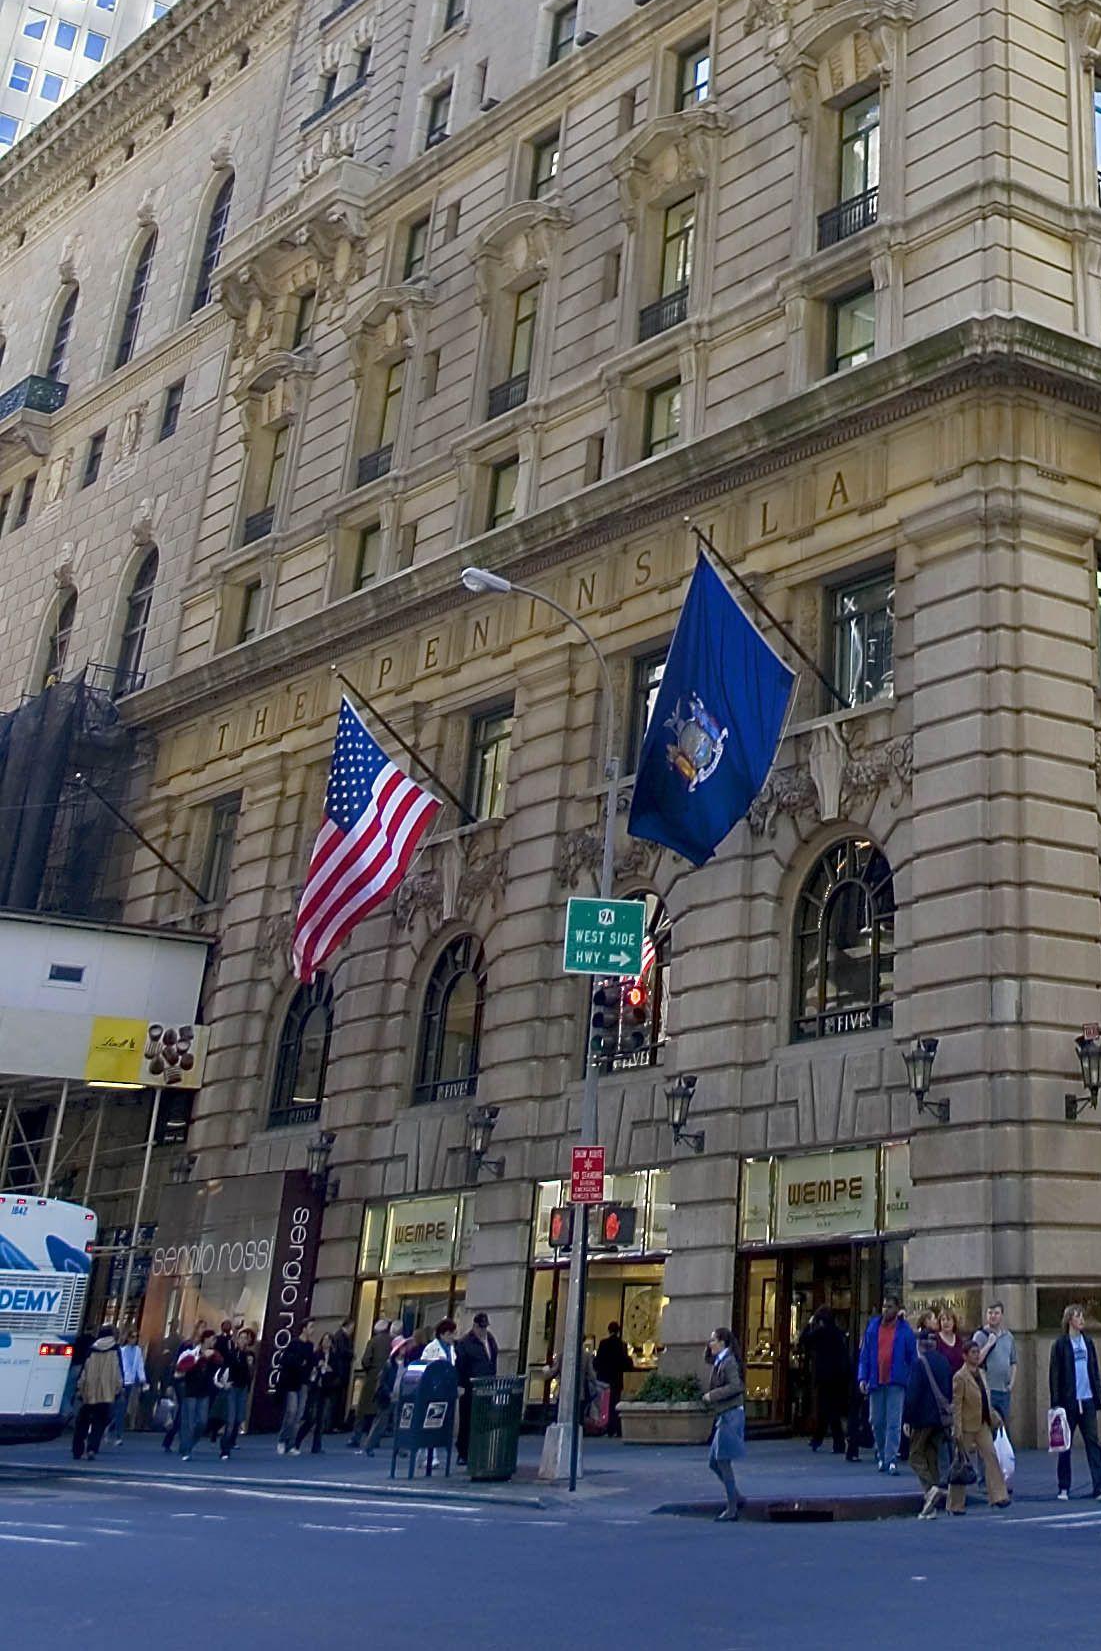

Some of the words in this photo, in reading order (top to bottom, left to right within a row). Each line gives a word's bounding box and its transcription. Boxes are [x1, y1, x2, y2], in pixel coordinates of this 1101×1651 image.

[217, 690, 308, 753] THE
[600, 910, 613, 923] 9A
[575, 929, 605, 946] WEST
[609, 931, 636, 947] SIDE
[576, 950, 601, 965] HWY
[838, 1011, 872, 1032] FIVES
[788, 1175, 863, 1206] WEMPE
[395, 1221, 446, 1245] WEMPE
[152, 1241, 214, 1280] sergio
[216, 1234, 275, 1274] rossi
[281, 1206, 310, 1305] sergio
